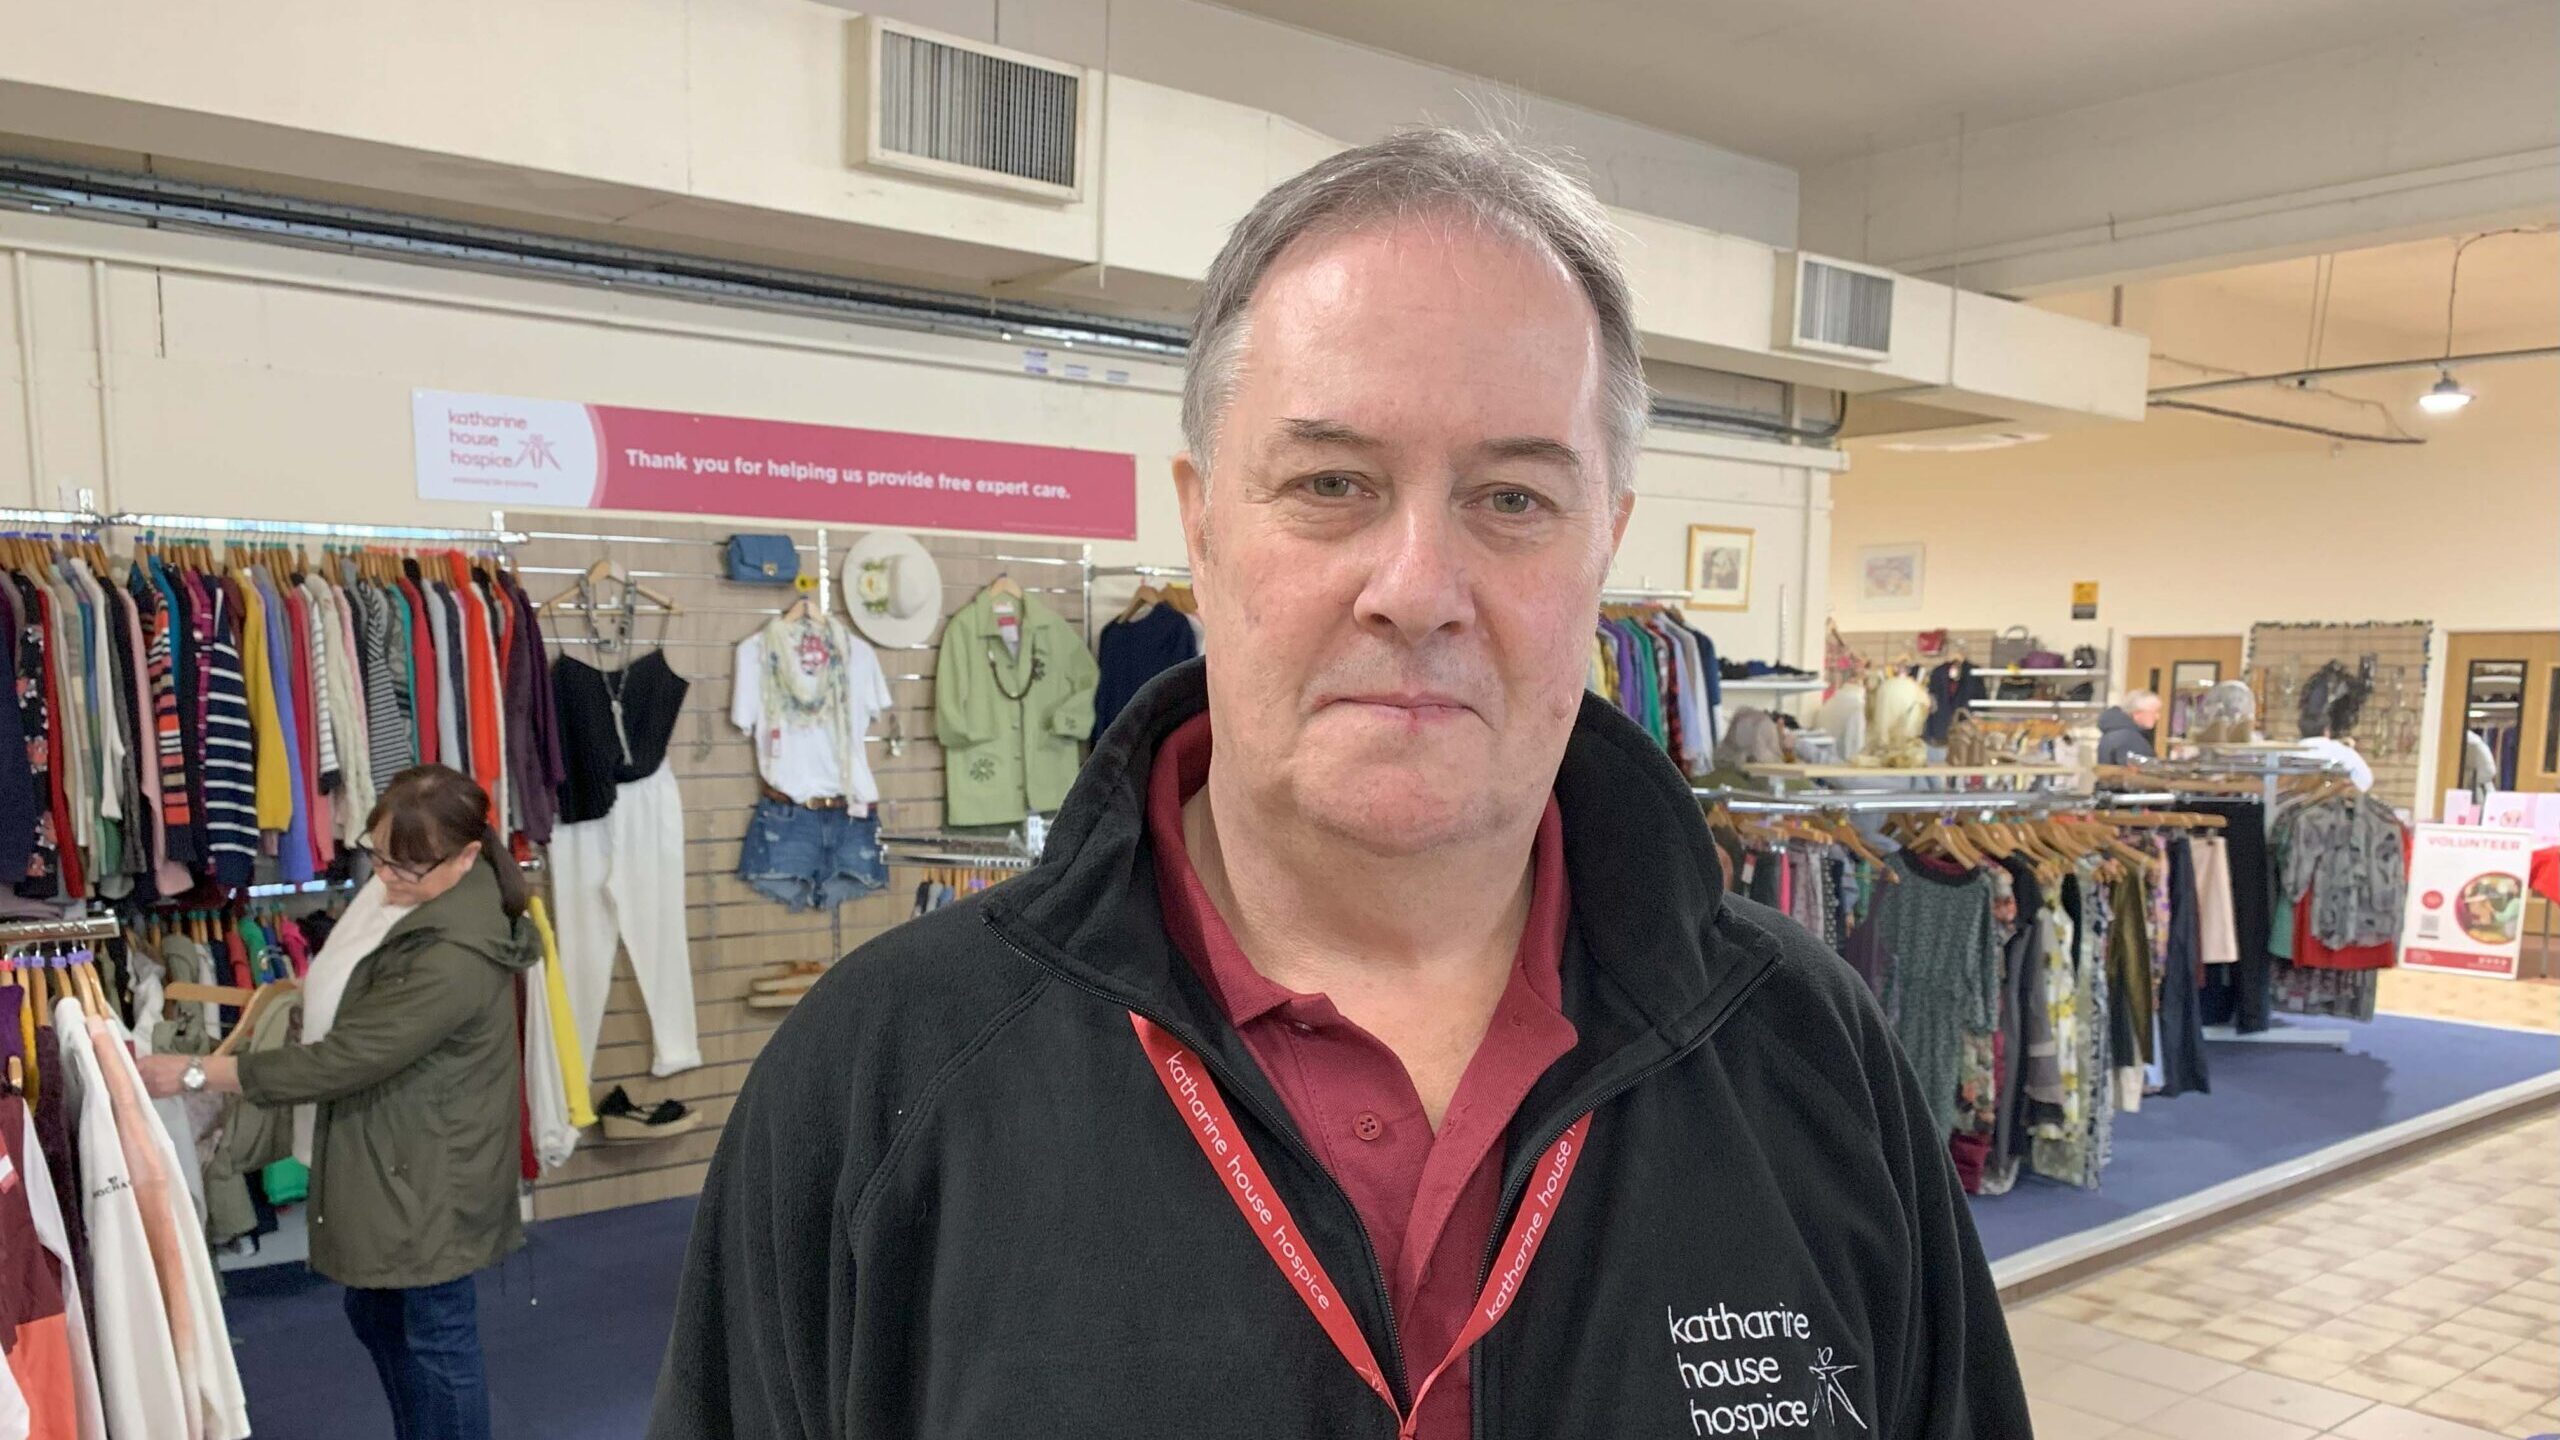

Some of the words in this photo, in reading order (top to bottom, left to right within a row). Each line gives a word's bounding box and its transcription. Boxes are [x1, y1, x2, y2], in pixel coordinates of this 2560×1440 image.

[448, 408, 527, 430] katharine
[449, 428, 499, 447] house
[450, 449, 513, 470] hospice
[625, 448, 688, 471] Thank
[693, 457, 730, 475] you
[735, 456, 763, 476] for
[768, 458, 838, 485] helping
[842, 468, 863, 484] us
[867, 470, 934, 487] provide
[938, 473, 972, 492] free
[976, 478, 1029, 497] expert
[1032, 482, 1071, 499] care.
[2427, 835, 2522, 851] VOLUNTEER
[1166, 1049, 1228, 1156] katharine
[1226, 1153, 1273, 1226] house
[1272, 1224, 1330, 1310] hospice
[1485, 1211, 1543, 1321] katharine
[1536, 1139, 1572, 1209] house
[1676, 1351, 1782, 1389] house
[1689, 1392, 1810, 1440] hospice
